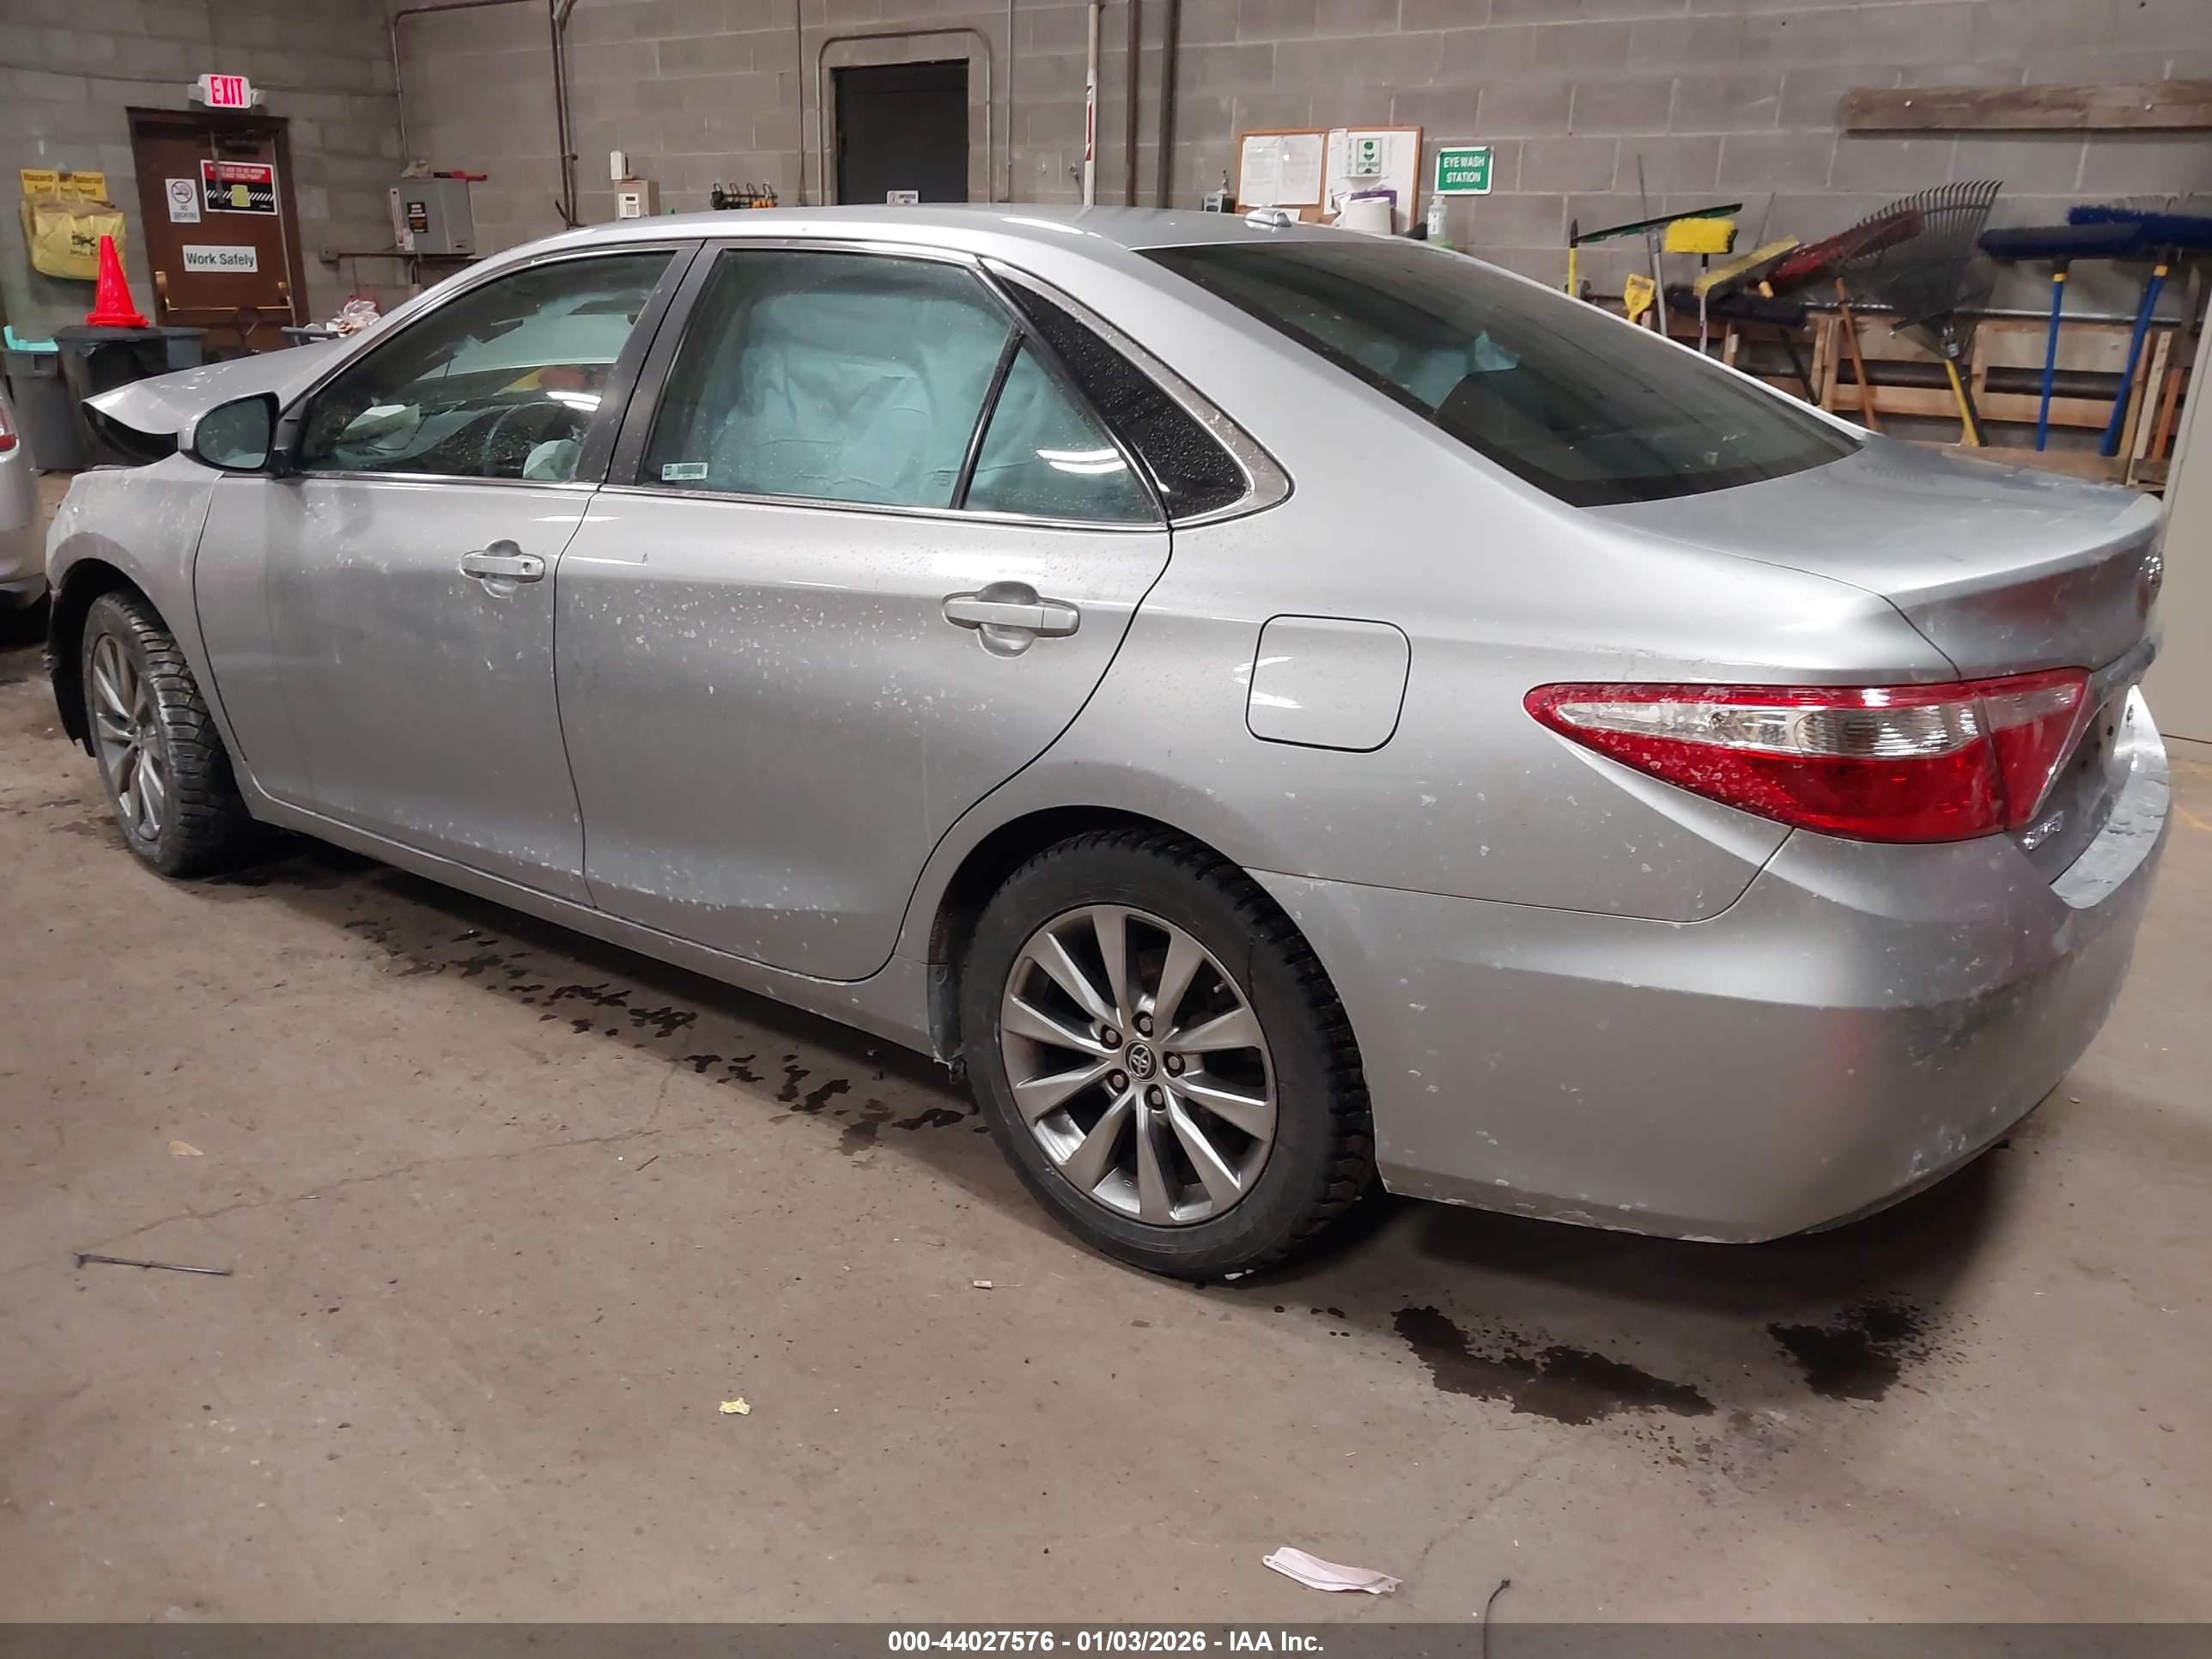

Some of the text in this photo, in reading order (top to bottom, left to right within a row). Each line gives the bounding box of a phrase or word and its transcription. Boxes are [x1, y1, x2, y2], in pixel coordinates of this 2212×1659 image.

[210, 76, 243, 106] EXIT
[1443, 155, 1485, 168] EYE WASH
[1446, 171, 1481, 184] STATION
[185, 252, 254, 267] Work Safely
